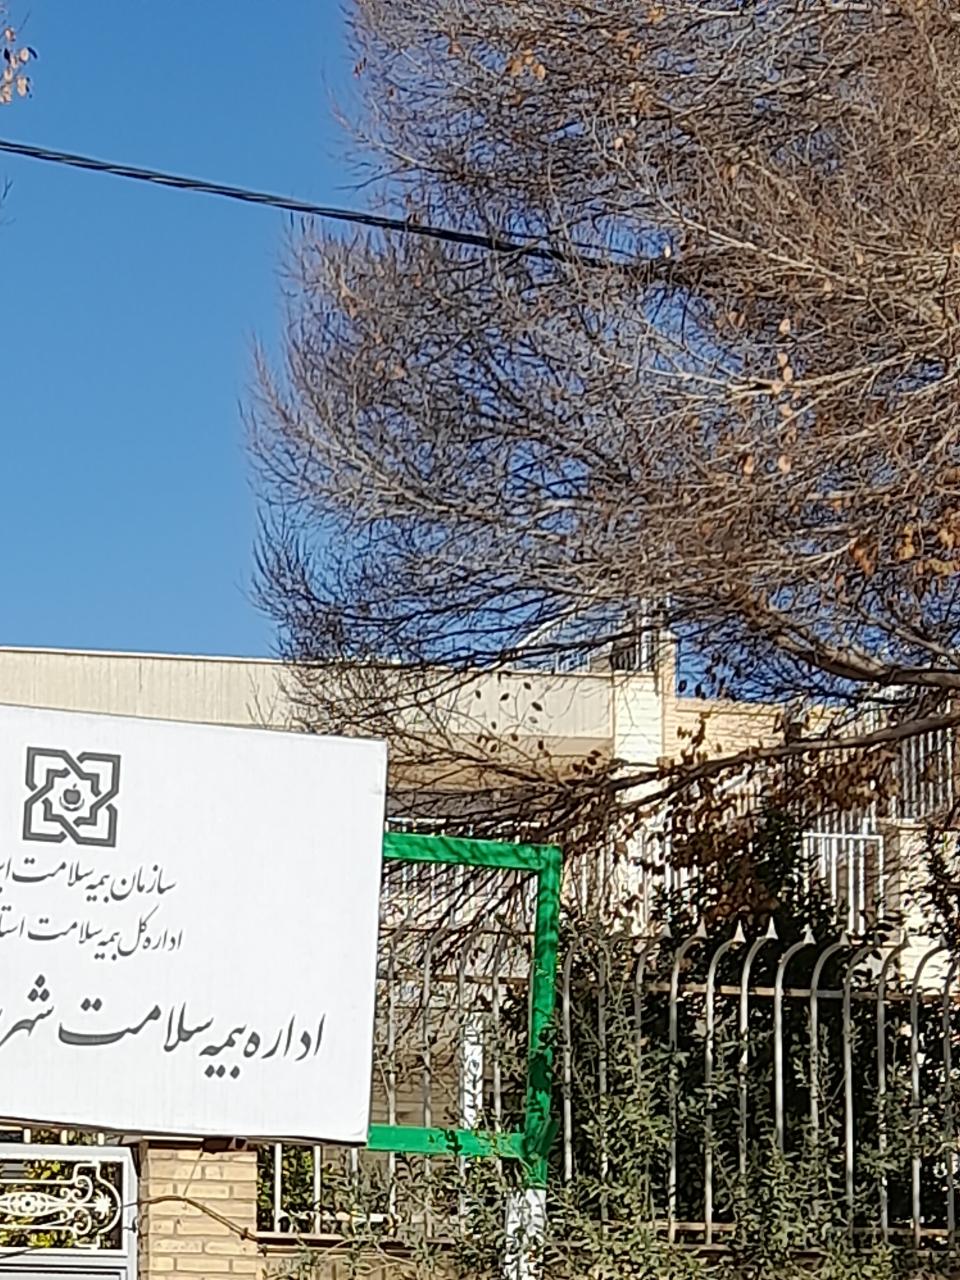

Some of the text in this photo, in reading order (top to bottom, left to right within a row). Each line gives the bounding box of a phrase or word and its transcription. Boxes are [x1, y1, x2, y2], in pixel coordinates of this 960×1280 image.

[12, 857, 95, 887] سلامت
[85, 873, 110, 903] بیمه
[110, 864, 177, 901] سازمان
[27, 917, 103, 944] سلامت
[94, 932, 120, 961] بیمه
[117, 903, 160, 957] کل
[142, 928, 183, 951] اداره
[58, 998, 214, 1053] سلامت
[243, 1013, 326, 1061] اداره
[199, 1023, 247, 1080] بیمه
